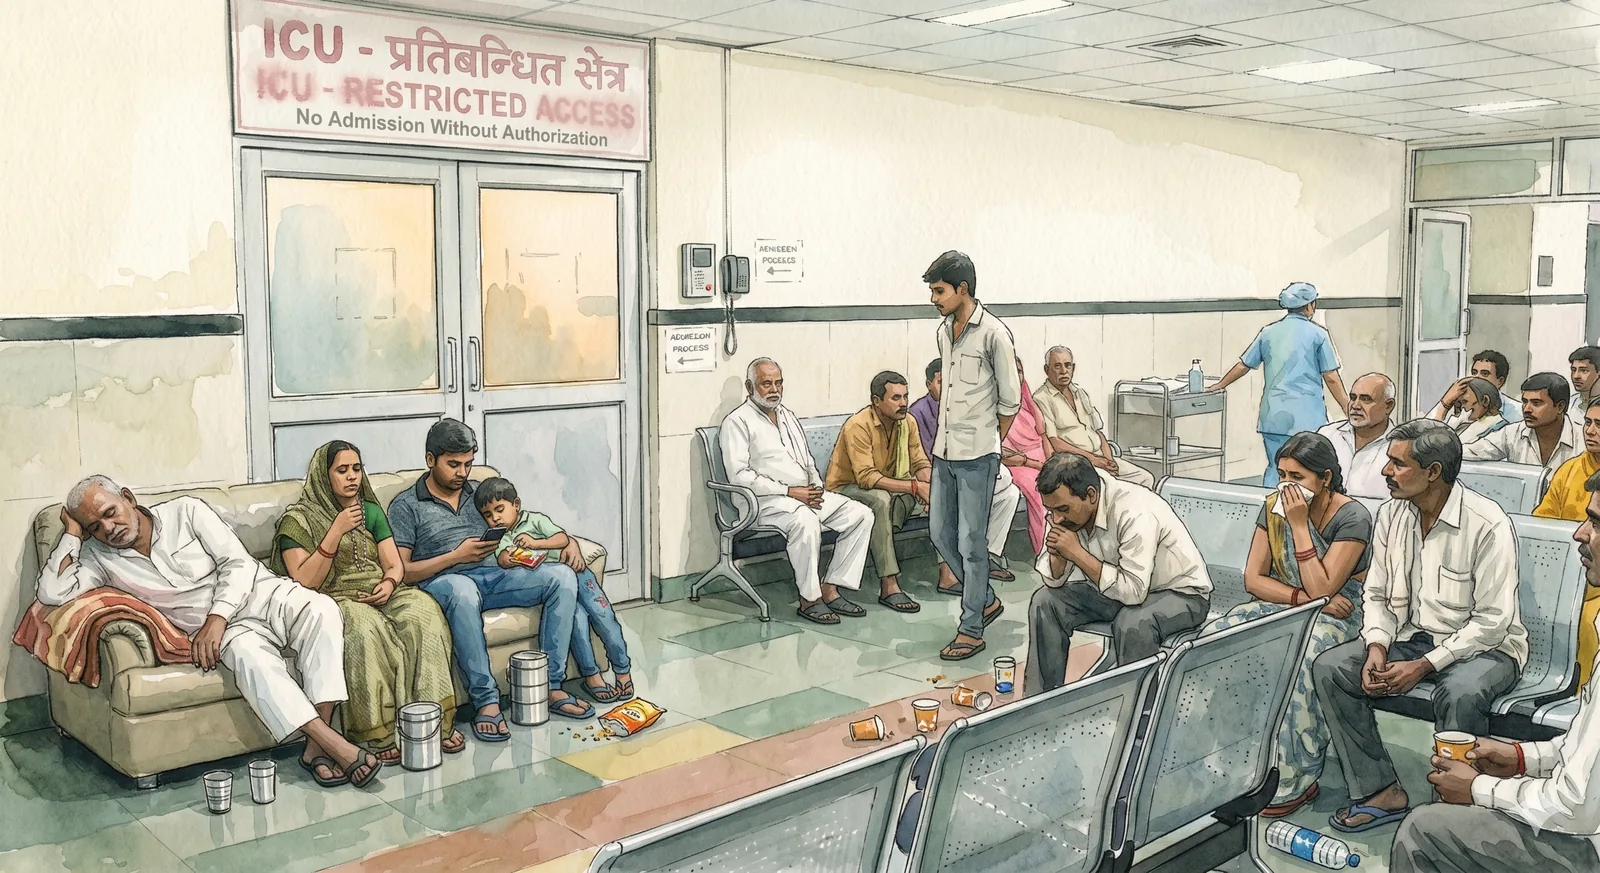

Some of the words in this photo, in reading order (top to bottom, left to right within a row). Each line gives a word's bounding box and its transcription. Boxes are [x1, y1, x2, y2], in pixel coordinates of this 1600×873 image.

[263, 17, 344, 64] ICU
[256, 68, 312, 102] ICU
[343, 76, 527, 118] RESTRICTED
[536, 94, 636, 130] ACCESS
[296, 107, 323, 126] No
[328, 110, 425, 133] Admission
[430, 118, 498, 139] Without
[502, 124, 608, 147] Authorization
[672, 344, 710, 353] PROCESS
